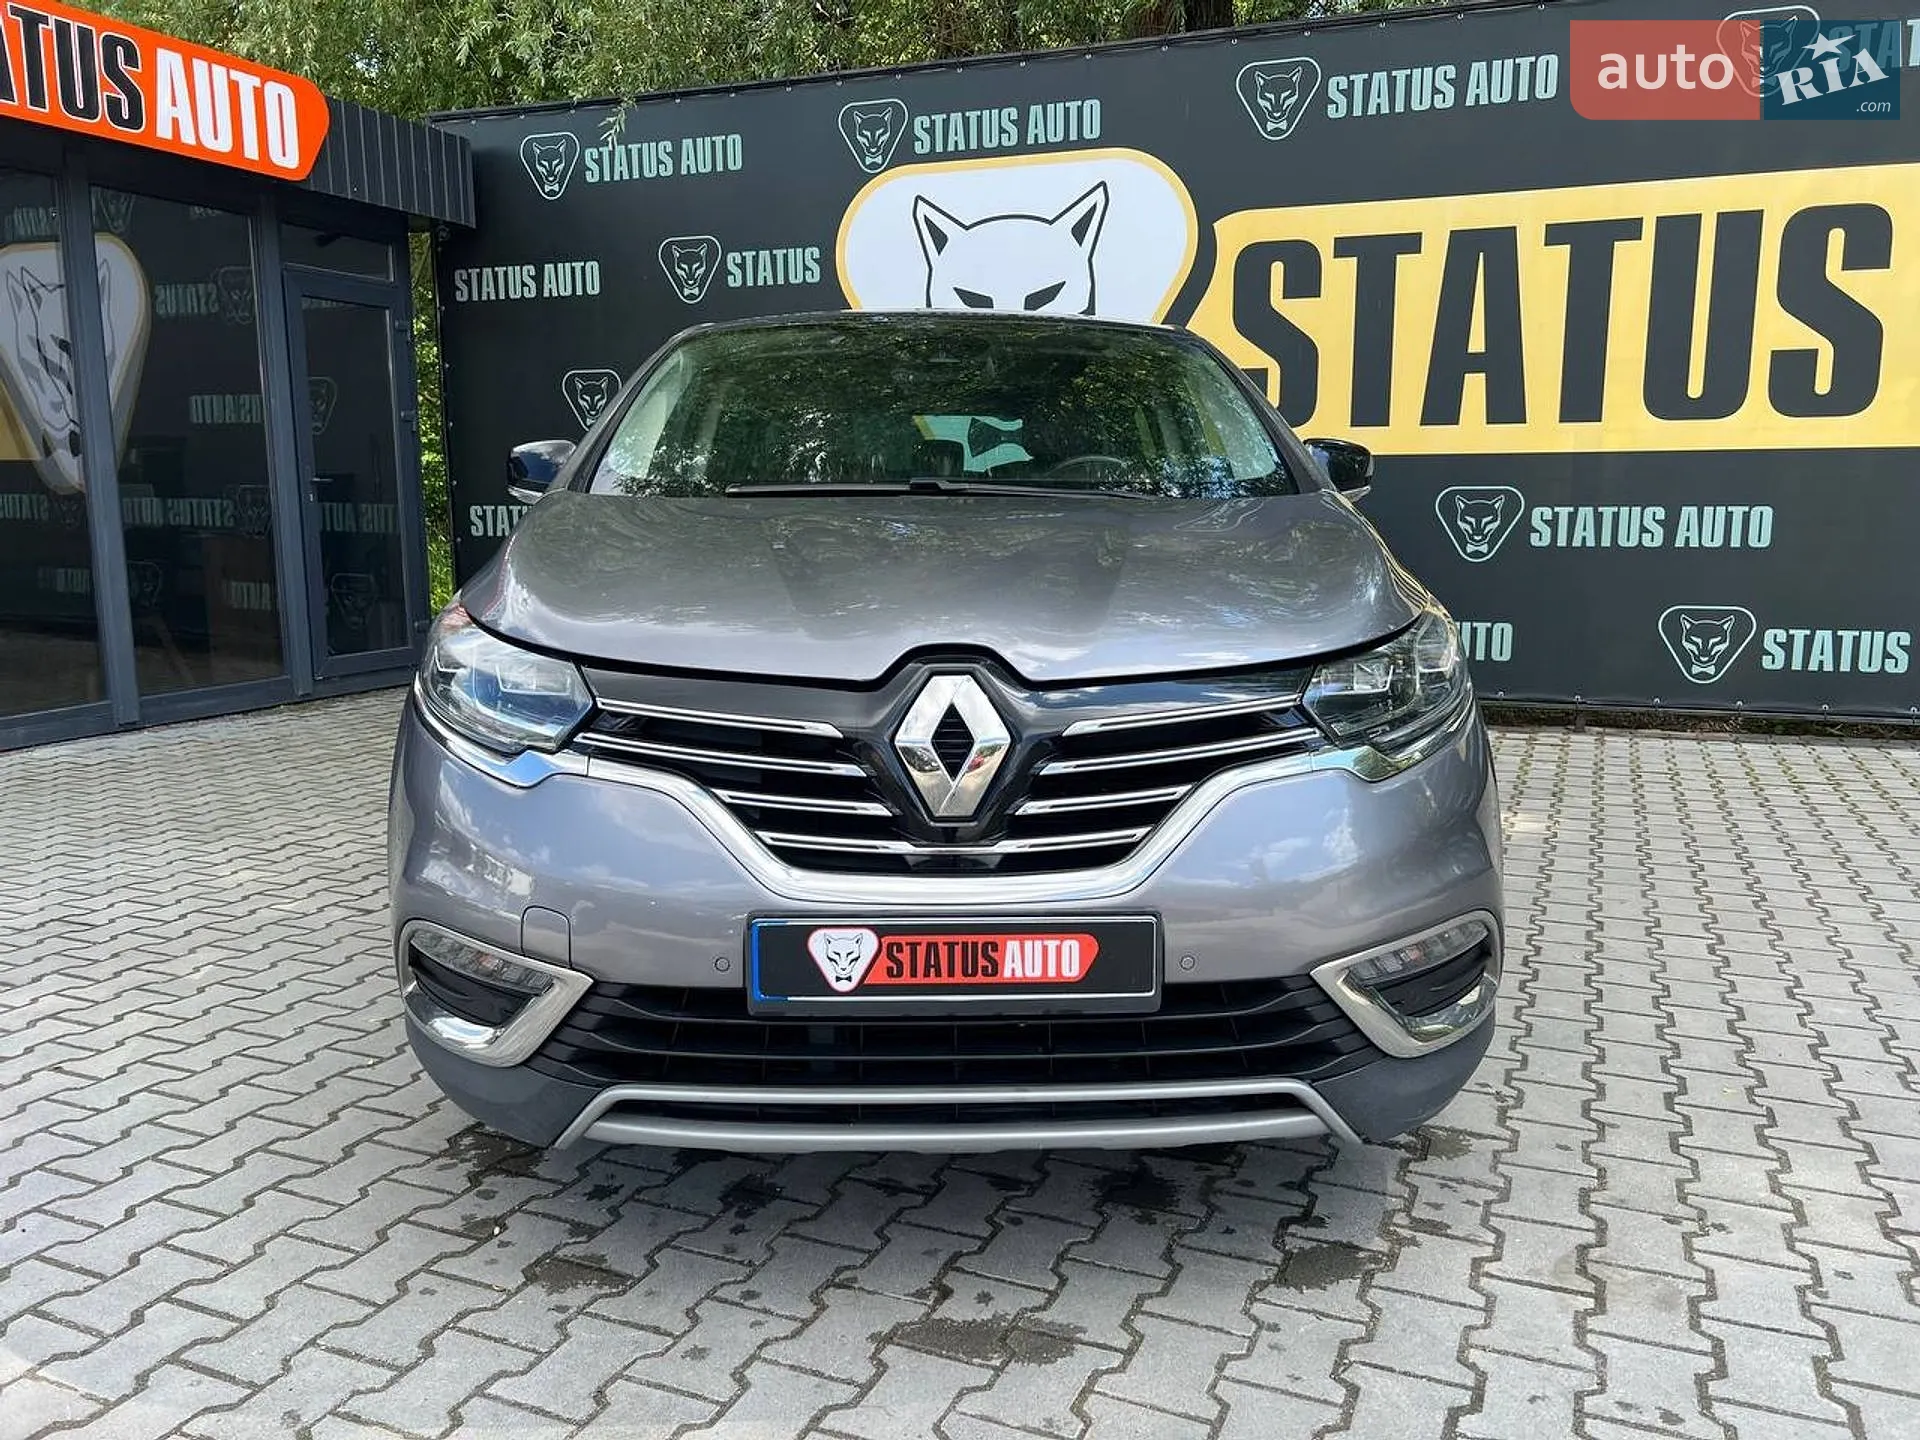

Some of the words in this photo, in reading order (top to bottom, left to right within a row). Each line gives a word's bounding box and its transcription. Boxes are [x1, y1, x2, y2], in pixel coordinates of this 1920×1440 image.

[155, 47, 300, 170] AUTO
[1327, 64, 1456, 119] STATUS
[1465, 54, 1559, 106] AUTO
[913, 107, 1018, 155] STATUS
[1027, 99, 1101, 145] AUTO
[584, 139, 674, 184] STATUS
[681, 133, 743, 174] AUTO
[454, 264, 537, 302] STATUS
[543, 260, 600, 297] AUTO
[726, 246, 821, 287] STATUS
[1232, 203, 1893, 428] STATUS
[469, 505, 532, 537] STAT
[1530, 506, 1664, 548] STATUS
[1674, 505, 1774, 548] AUTO
[1762, 628, 1911, 674] STATUS
[886, 941, 999, 979] STATUS
[1004, 939, 1081, 978] AUTO
